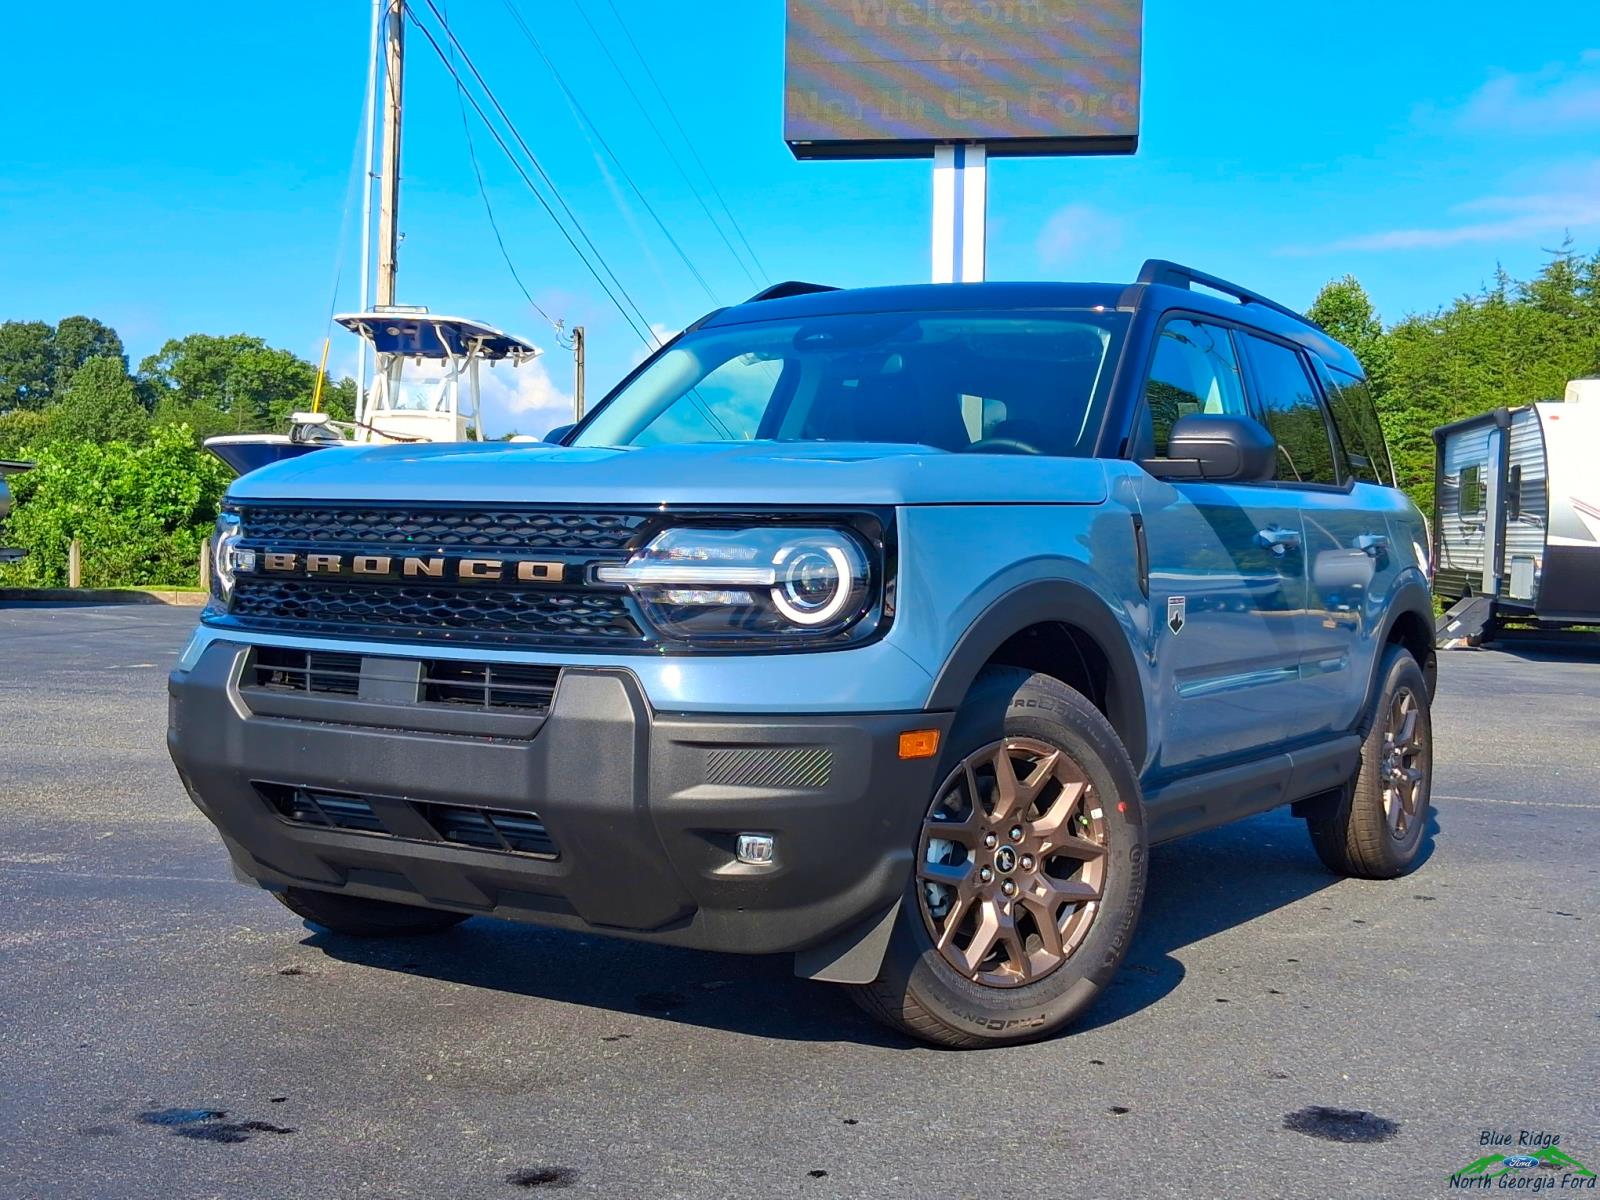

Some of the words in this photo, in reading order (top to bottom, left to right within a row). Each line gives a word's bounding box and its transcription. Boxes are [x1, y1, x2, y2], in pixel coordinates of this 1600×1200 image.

[852, 0, 1075, 26] Welcome
[938, 42, 985, 72] to
[787, 89, 925, 122] North
[943, 88, 1009, 121] Ga
[1029, 83, 1138, 118] Ford
[264, 552, 566, 582] BRONCO
